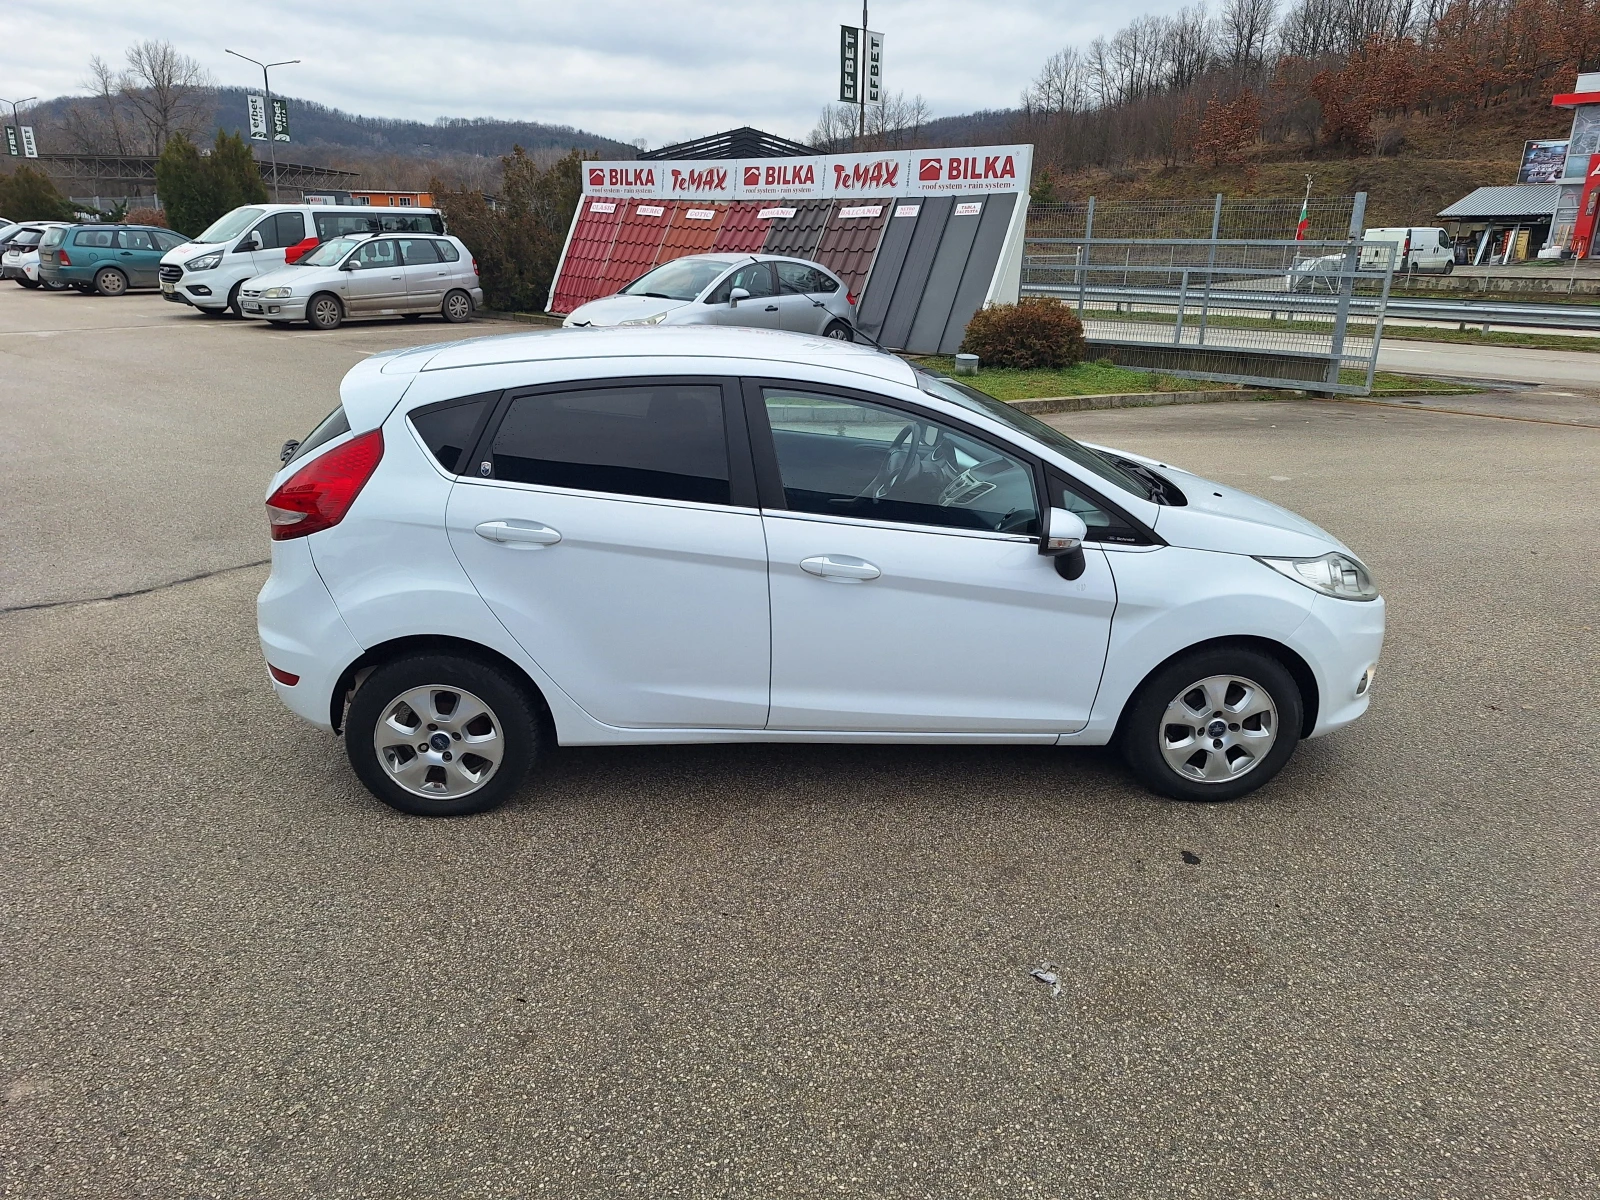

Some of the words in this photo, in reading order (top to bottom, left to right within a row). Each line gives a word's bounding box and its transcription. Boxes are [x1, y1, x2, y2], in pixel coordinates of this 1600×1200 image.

[844, 31, 856, 98] EFBET
[869, 36, 881, 101] EFBET
[250, 98, 260, 128] efbet
[273, 101, 283, 132] efbet
[7, 127, 18, 155] EFBET
[24, 128, 35, 156] EFBET
[609, 168, 655, 186] BILKA
[764, 165, 815, 186] BILKA
[947, 155, 1016, 180] BILKA
[922, 182, 938, 190] roof
[938, 183, 962, 191] system
[968, 181, 983, 189] rain
[984, 182, 1011, 190] system
[840, 207, 881, 216] BALCANIC
